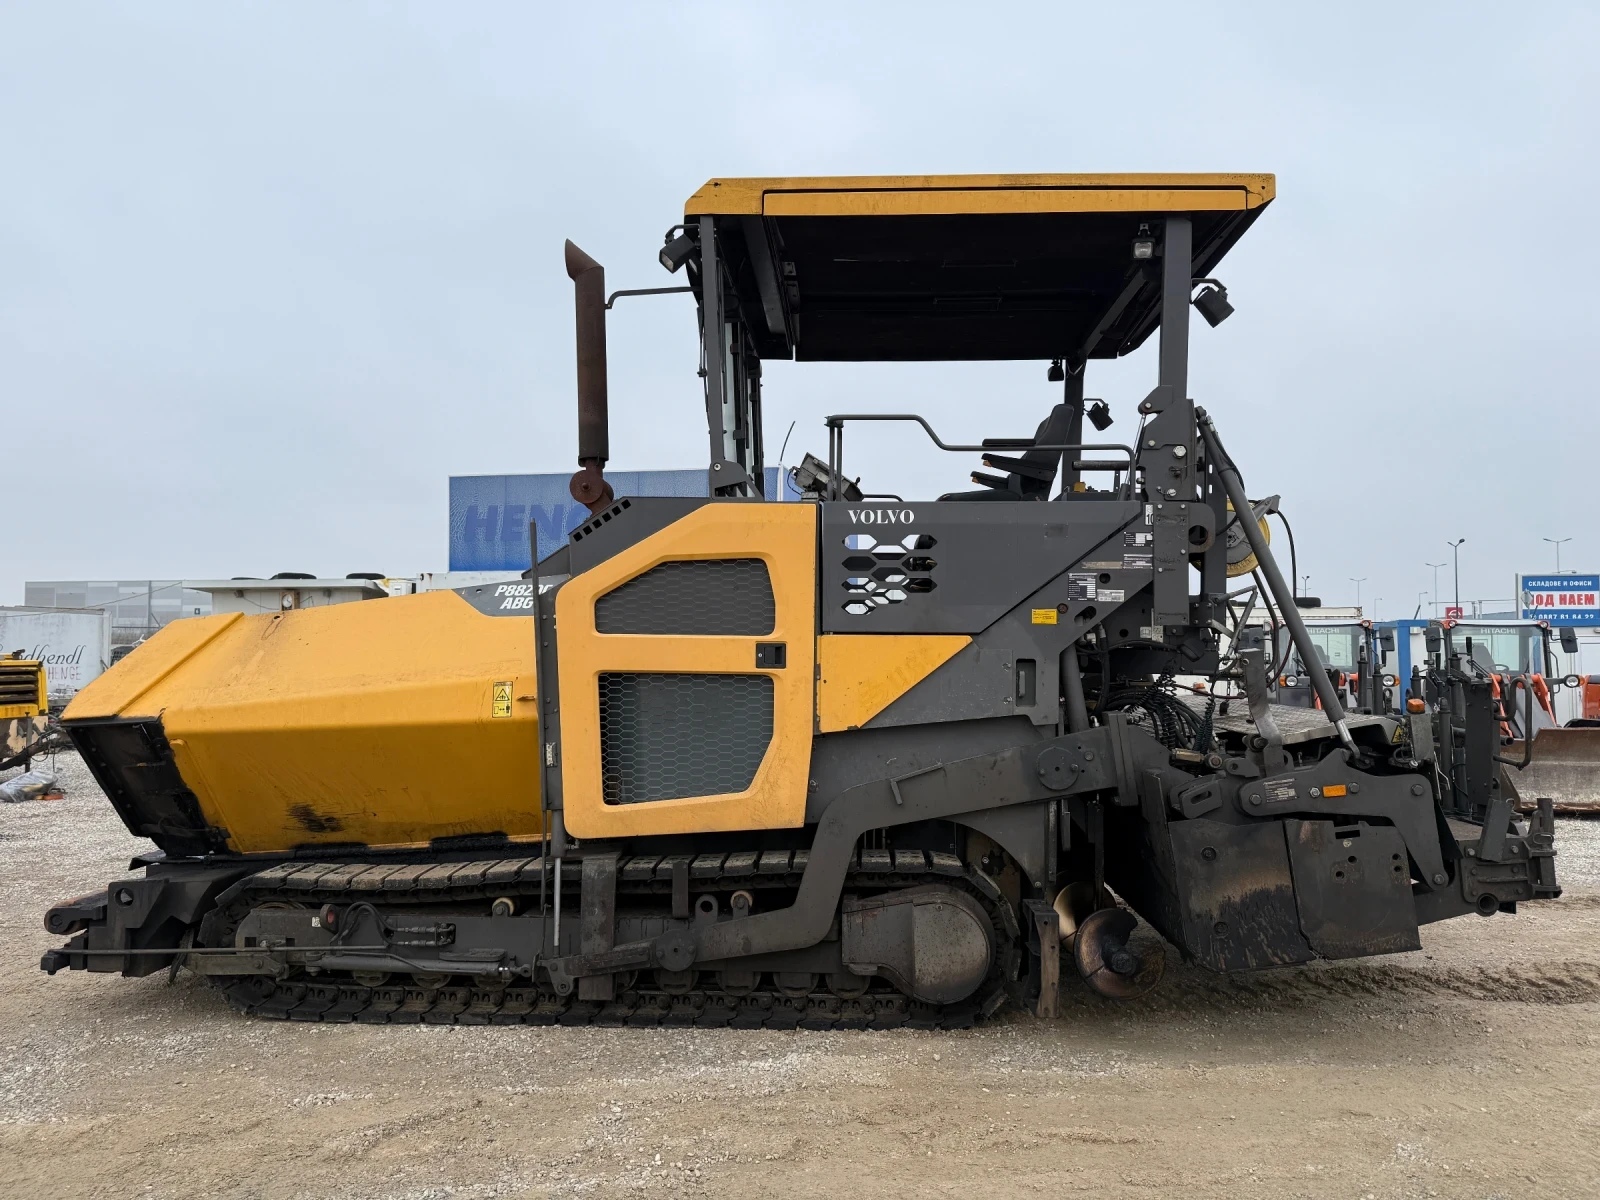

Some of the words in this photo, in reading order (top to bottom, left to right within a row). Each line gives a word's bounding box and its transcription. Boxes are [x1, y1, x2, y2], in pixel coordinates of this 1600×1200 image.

[847, 509, 915, 525] VOLVO
[499, 596, 534, 610] ABG
[1559, 593, 1595, 606] НАЕМ
